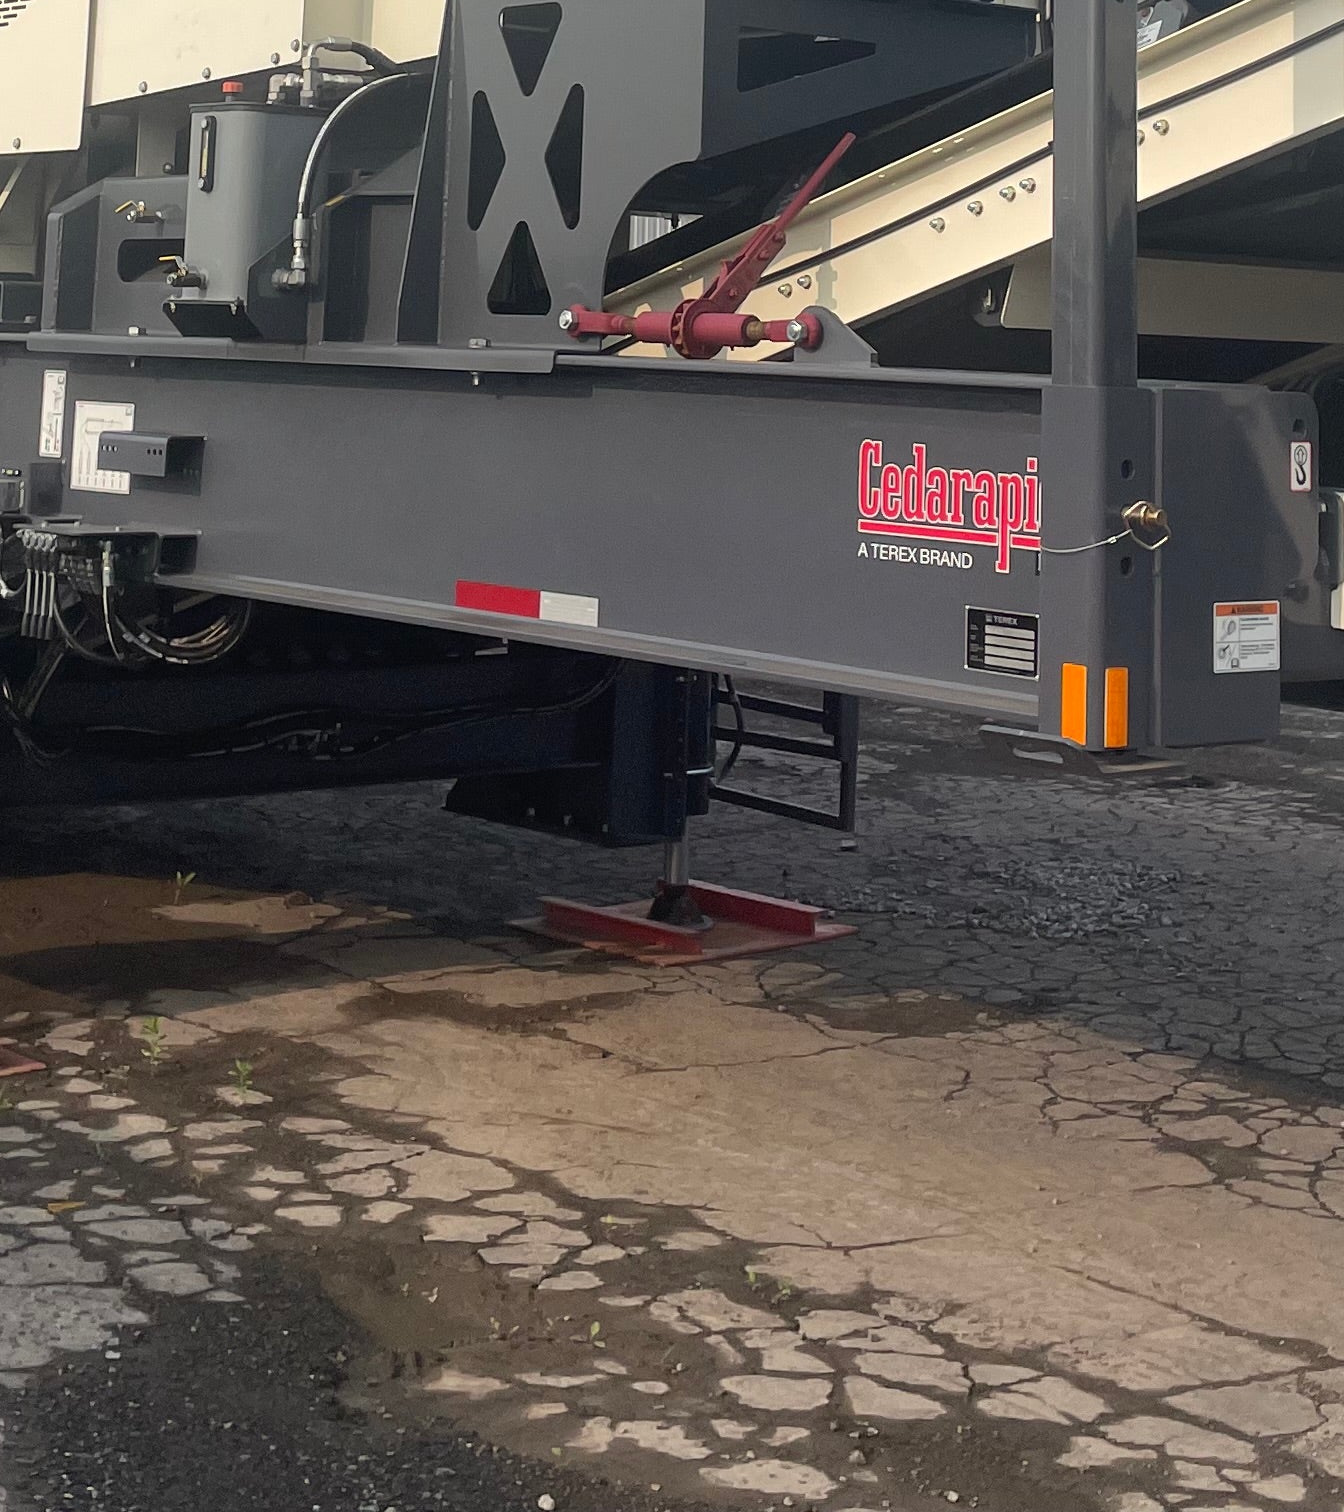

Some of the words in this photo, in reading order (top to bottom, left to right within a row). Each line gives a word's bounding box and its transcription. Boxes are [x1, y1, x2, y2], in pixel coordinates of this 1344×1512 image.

[858, 439, 1042, 573] Cedarapi
[858, 542, 869, 558] A
[870, 543, 918, 563] TEREX
[919, 549, 973, 569] BRAND
